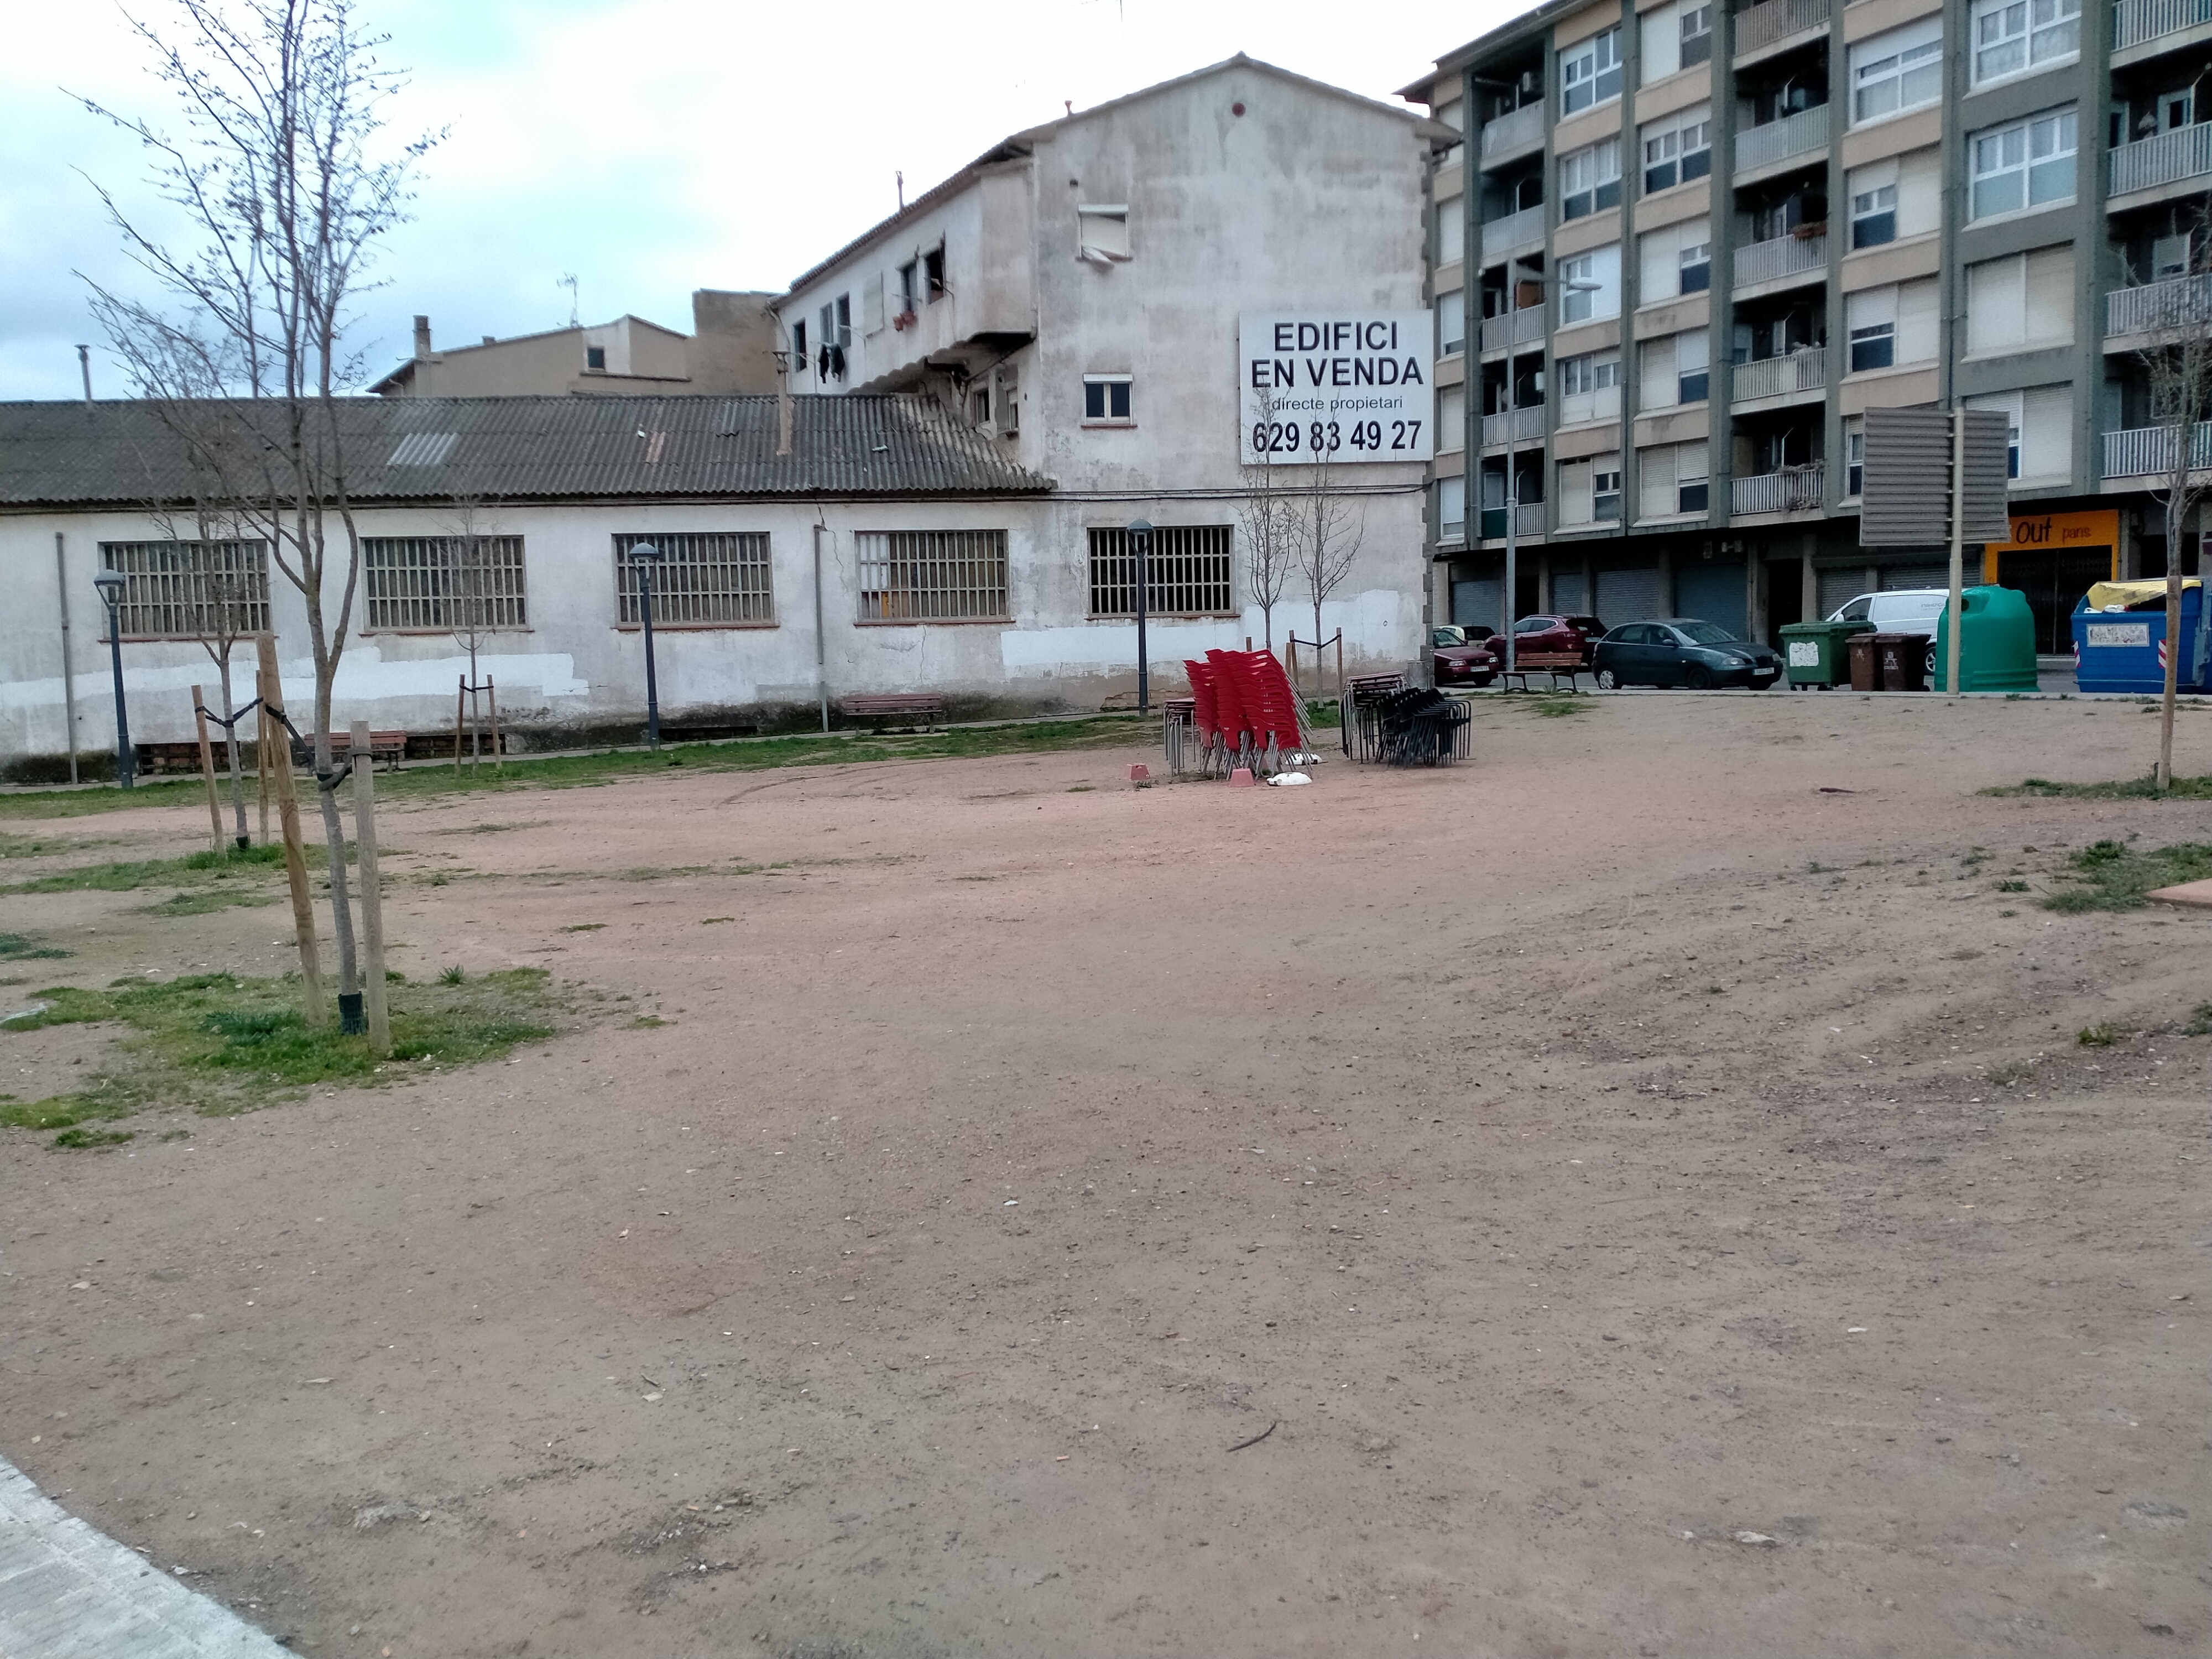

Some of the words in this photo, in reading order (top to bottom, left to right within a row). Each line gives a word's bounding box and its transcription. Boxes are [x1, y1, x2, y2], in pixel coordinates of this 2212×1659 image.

[1274, 321, 1397, 351] EDIFICI
[1251, 358, 1295, 388] EN
[1306, 356, 1424, 386] VENDA
[1272, 398, 1324, 410] directe
[1331, 396, 1402, 412] propietari
[1253, 421, 1300, 452] 629
[1310, 421, 1340, 451] 83
[1350, 420, 1381, 450] 49
[1391, 420, 1422, 449] 27
[2063, 527, 2091, 543] pans
